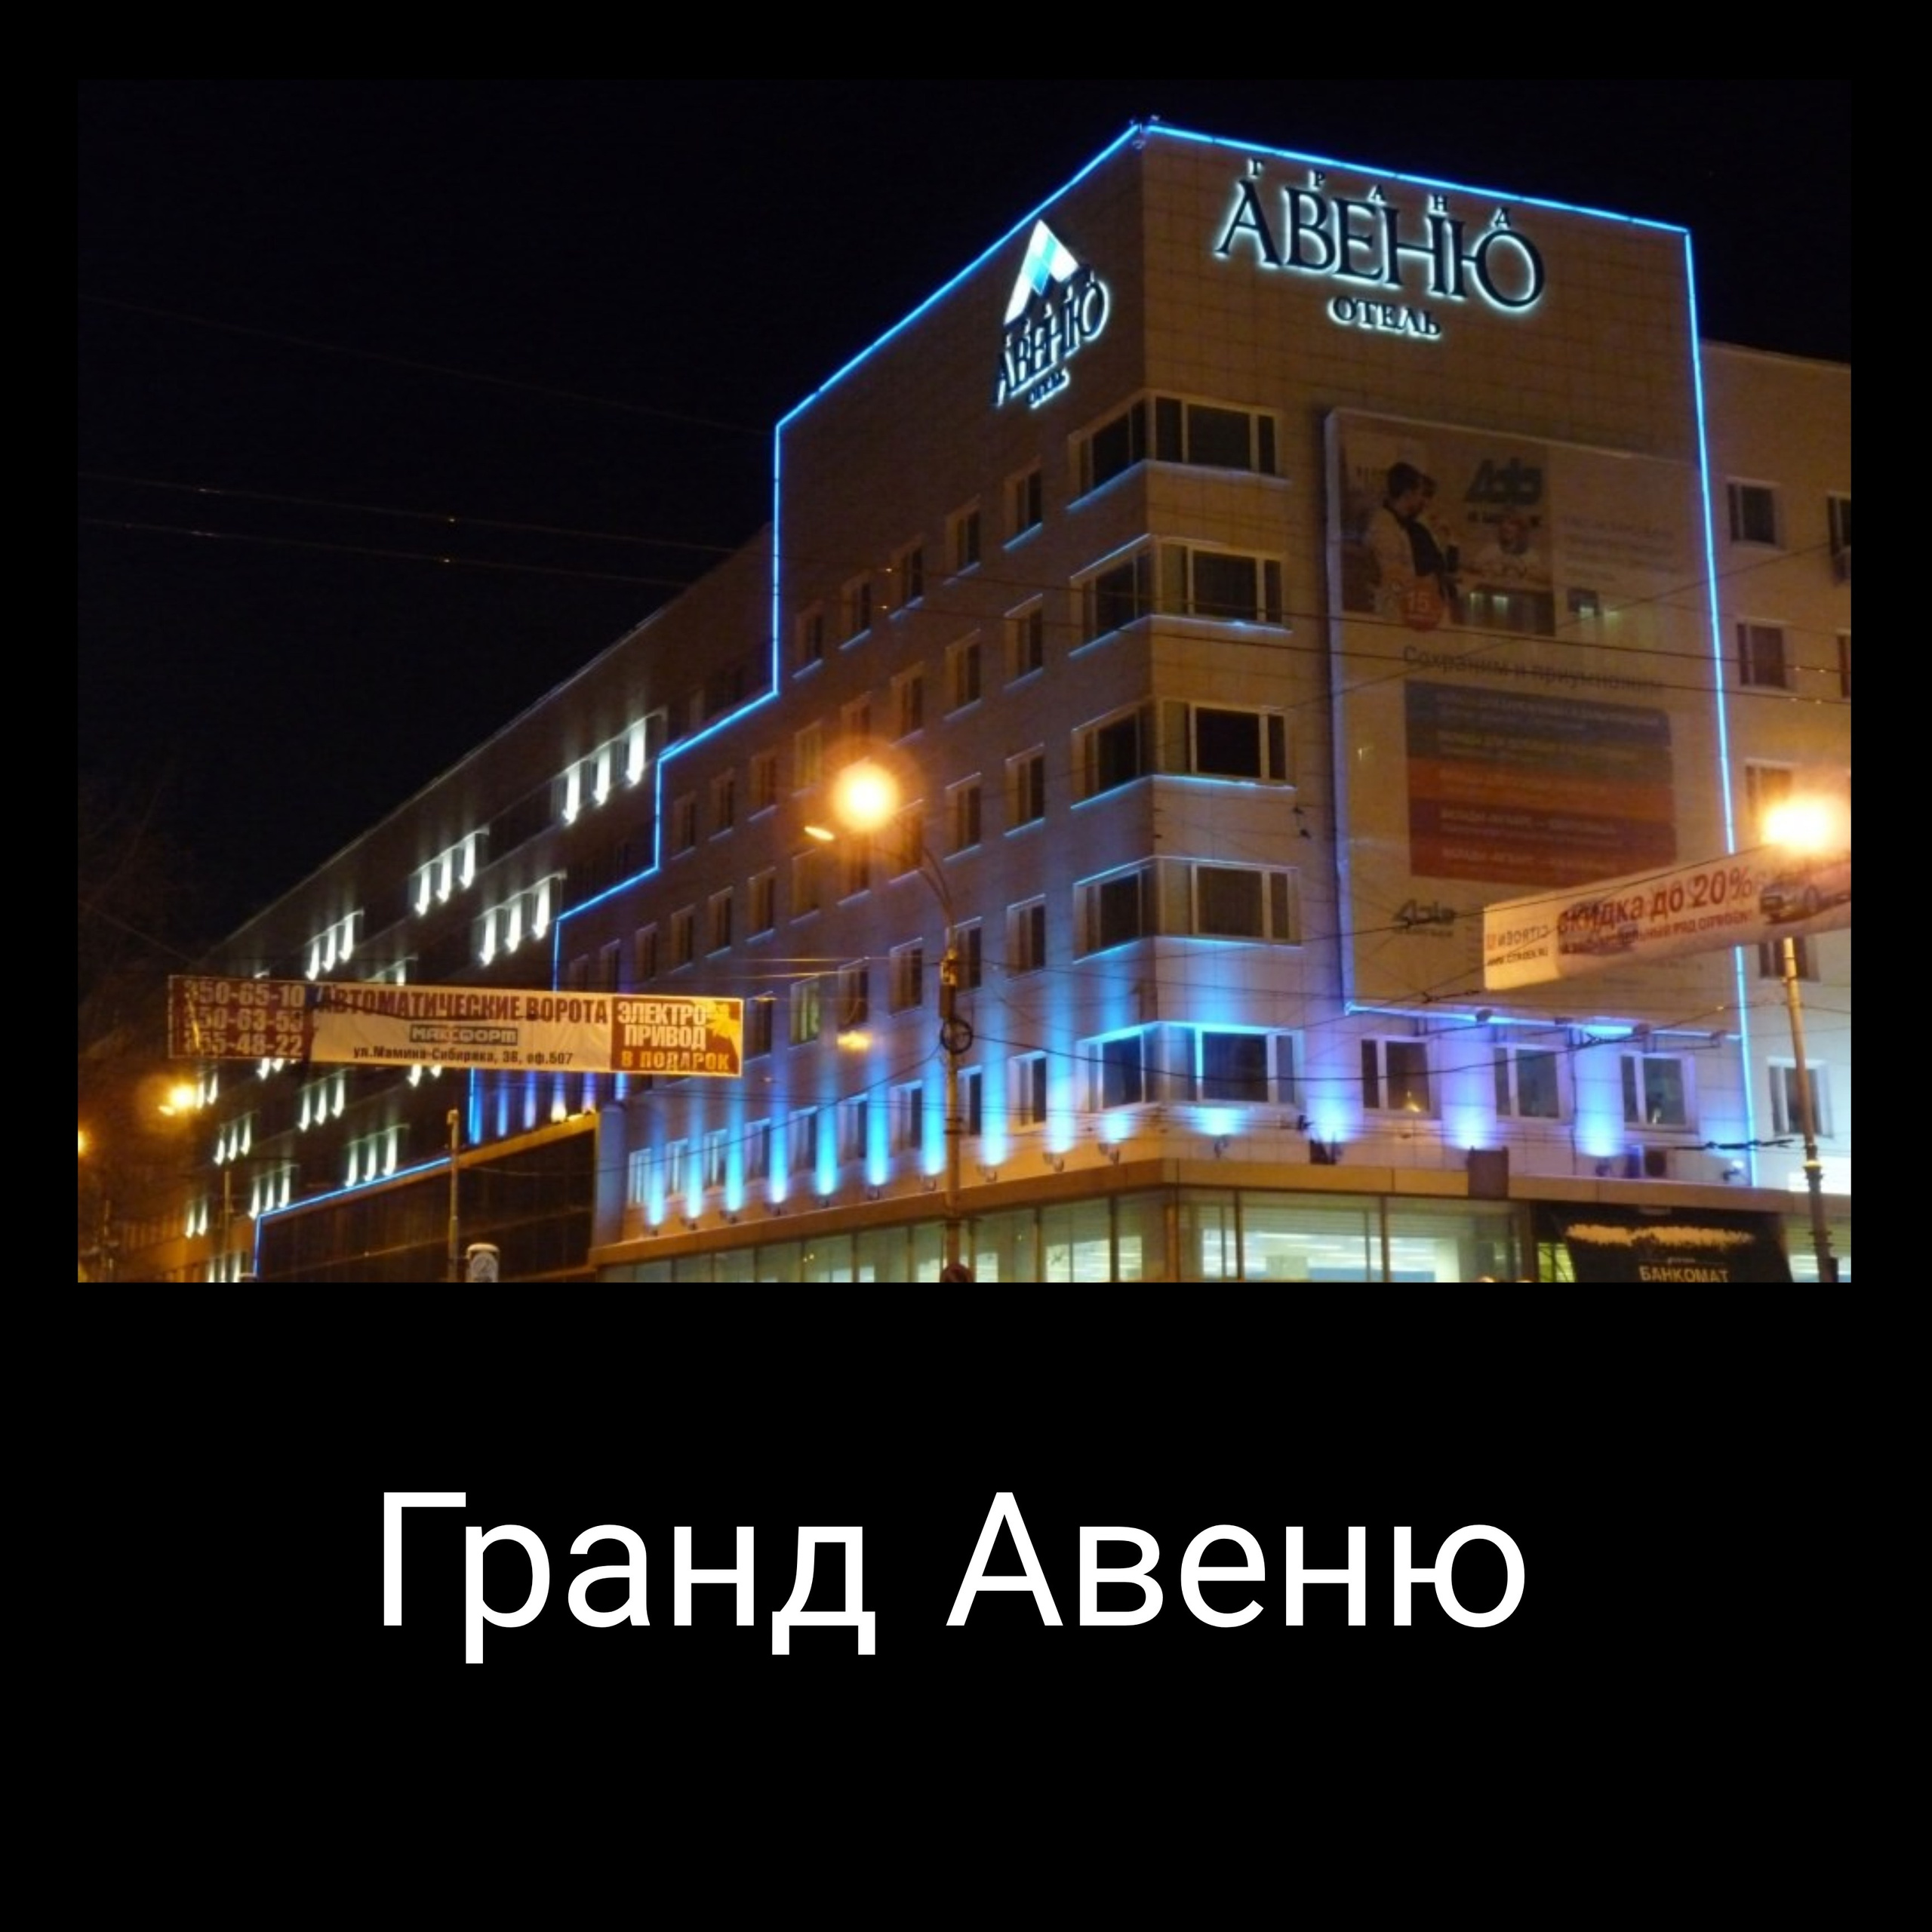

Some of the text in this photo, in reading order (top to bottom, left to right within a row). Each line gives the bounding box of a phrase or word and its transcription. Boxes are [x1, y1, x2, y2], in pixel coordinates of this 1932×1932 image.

[1212, 178, 1546, 315] АВЕНЮ
[1327, 296, 1442, 340] ОТЕЛЬ
[1692, 868, 1752, 909] 20%
[318, 984, 608, 1024] АВТОМАТИЧЕСКИЕ ВОРОТА
[624, 1024, 706, 1052] ПРИВОД
[639, 1051, 730, 1072] ПОДАРОК
[1638, 1265, 1729, 1283] БАНКОМАТ
